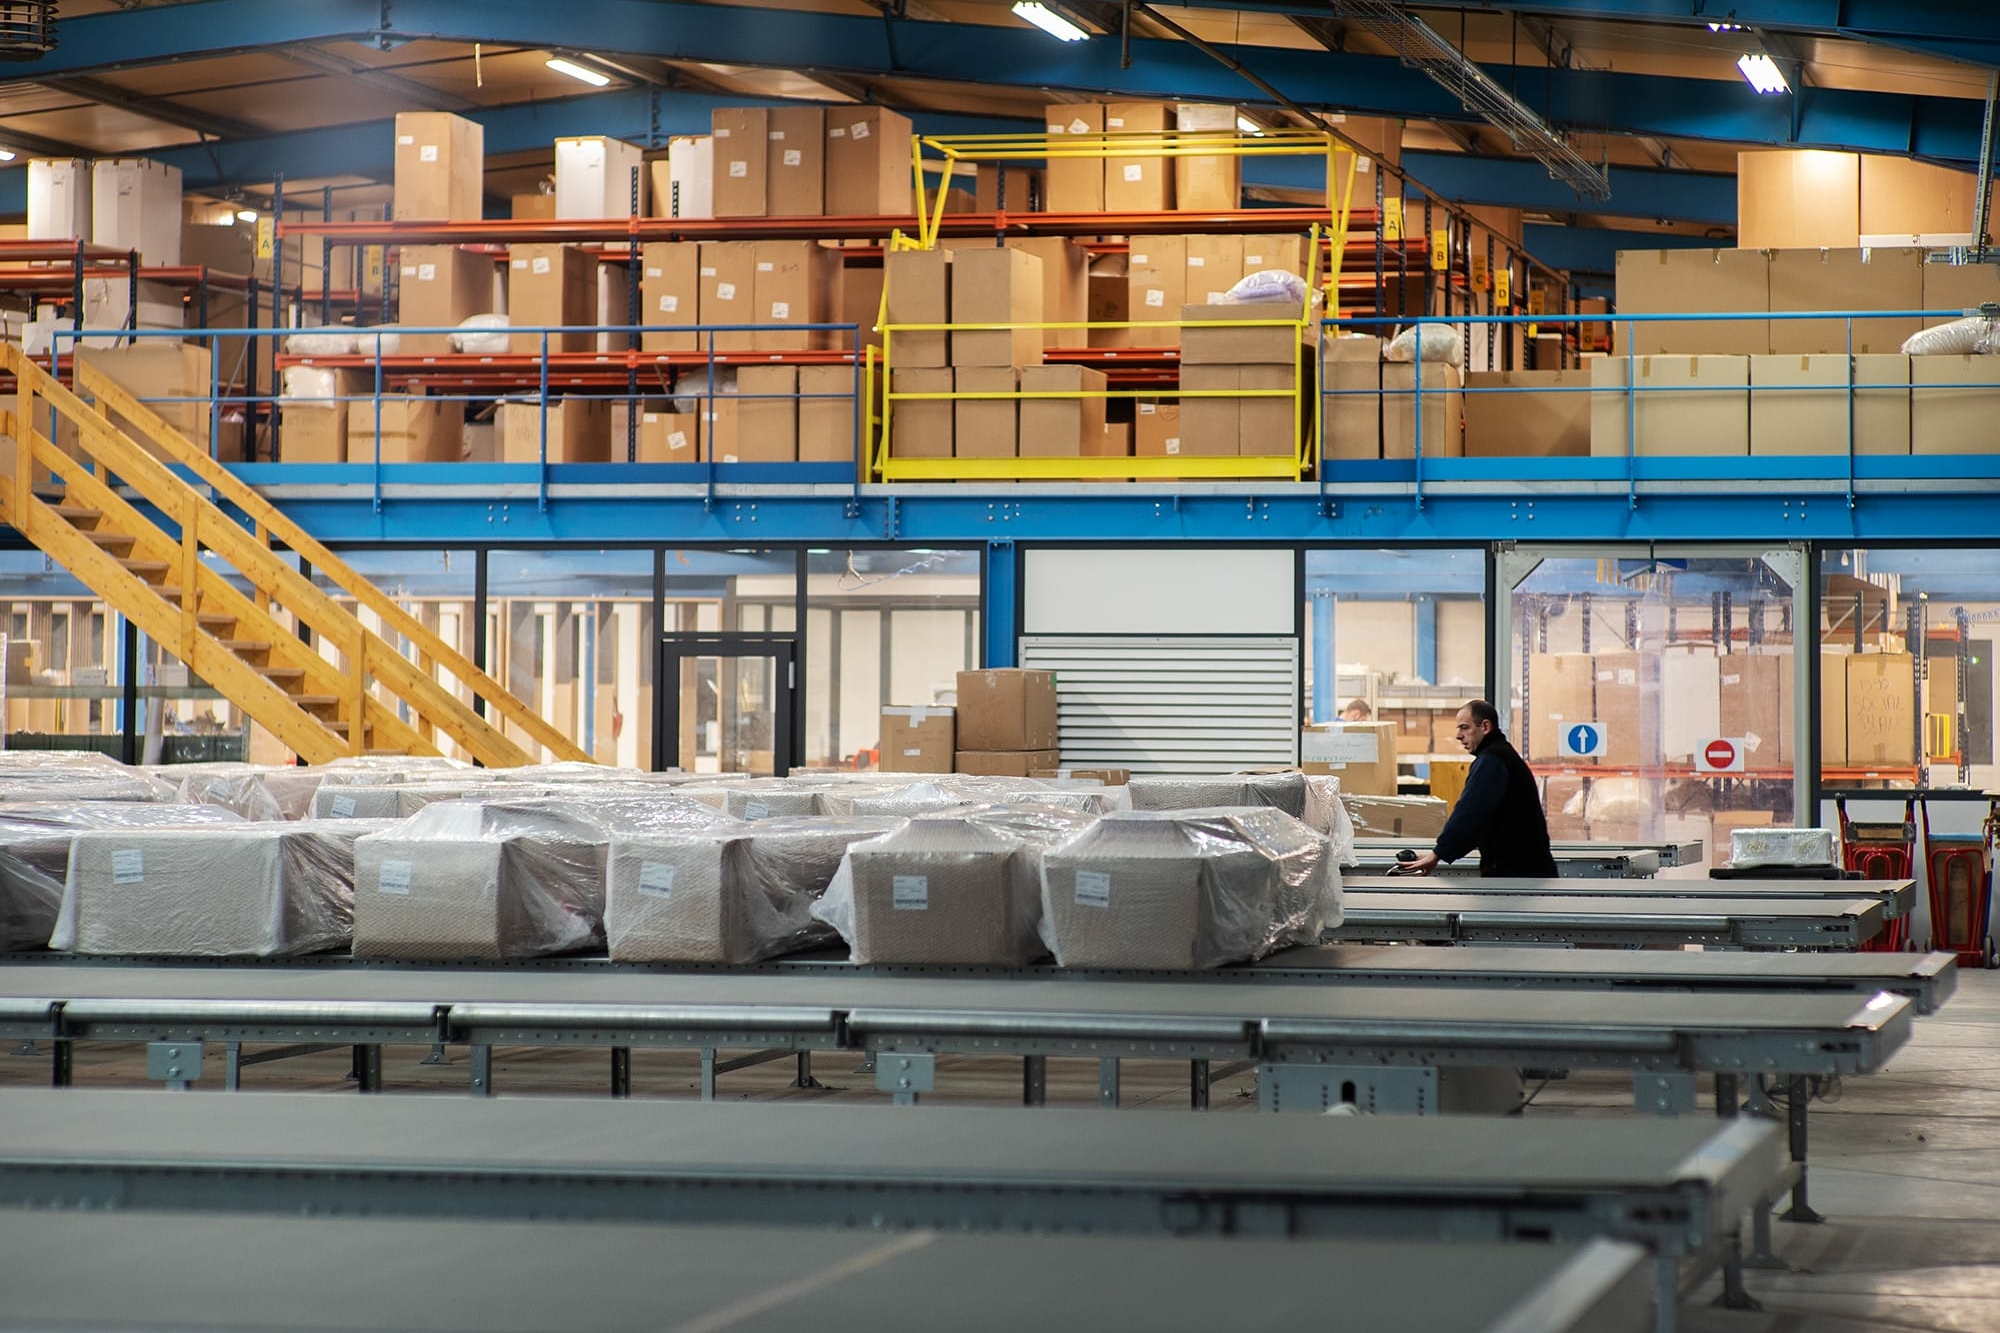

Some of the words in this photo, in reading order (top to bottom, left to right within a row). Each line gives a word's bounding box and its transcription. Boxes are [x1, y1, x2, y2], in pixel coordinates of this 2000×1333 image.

[1388, 221, 1397, 231] A
[261, 239, 270, 250] A
[1437, 251, 1444, 261] B
[1476, 274, 1484, 284] C
[1499, 289, 1506, 299] D
